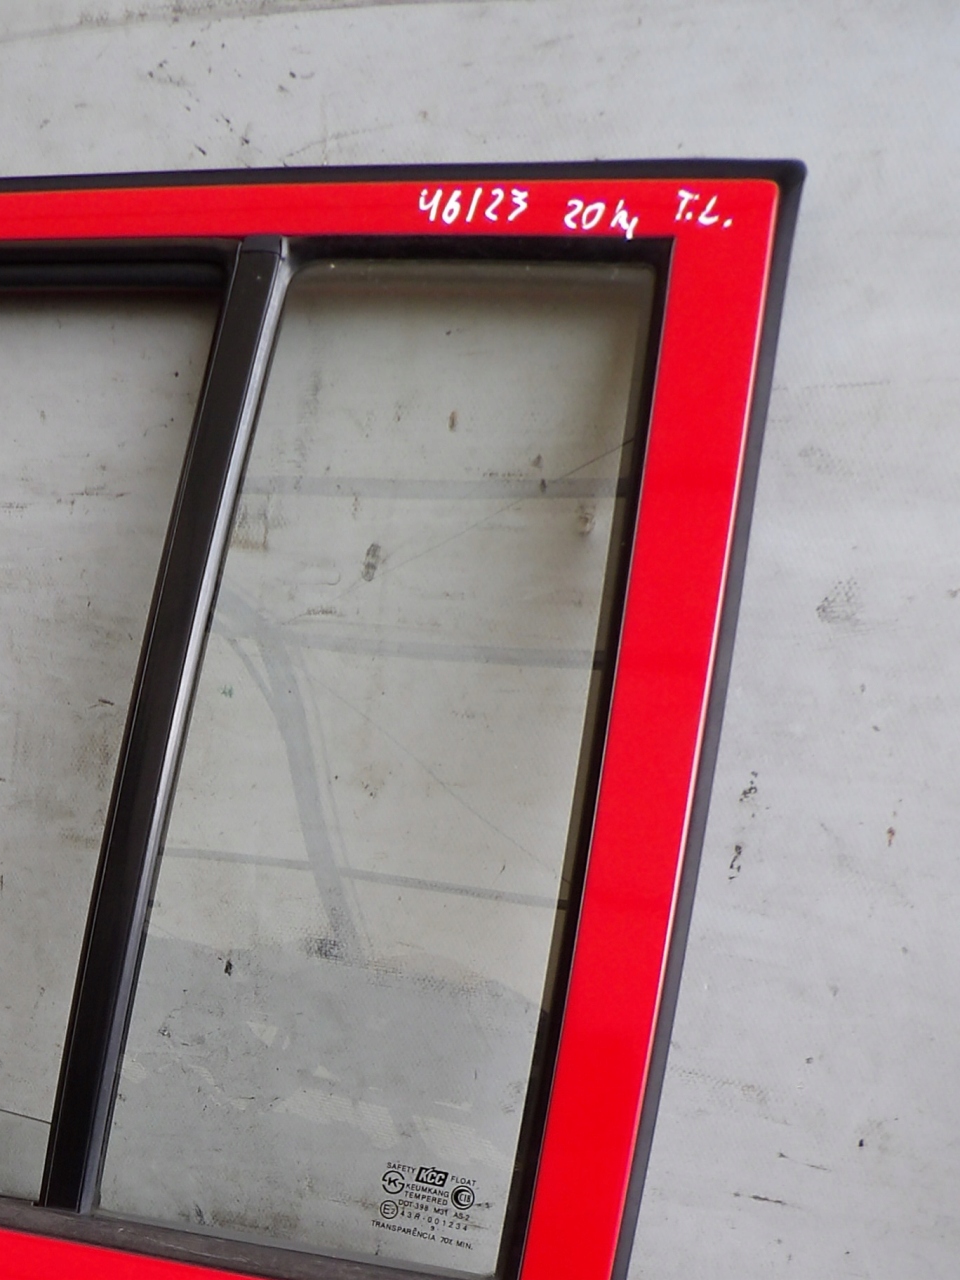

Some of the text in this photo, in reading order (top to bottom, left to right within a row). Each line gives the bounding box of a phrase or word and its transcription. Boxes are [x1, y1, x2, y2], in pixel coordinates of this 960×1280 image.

[418, 187, 528, 225] 46/23
[564, 199, 605, 230] 20
[387, 1162, 416, 1174] SAFETY
[419, 1166, 446, 1185] KCC
[451, 1176, 476, 1187] FLOAT
[405, 1184, 449, 1198] KEUMKANG
[404, 1191, 448, 1206] TEMPERED
